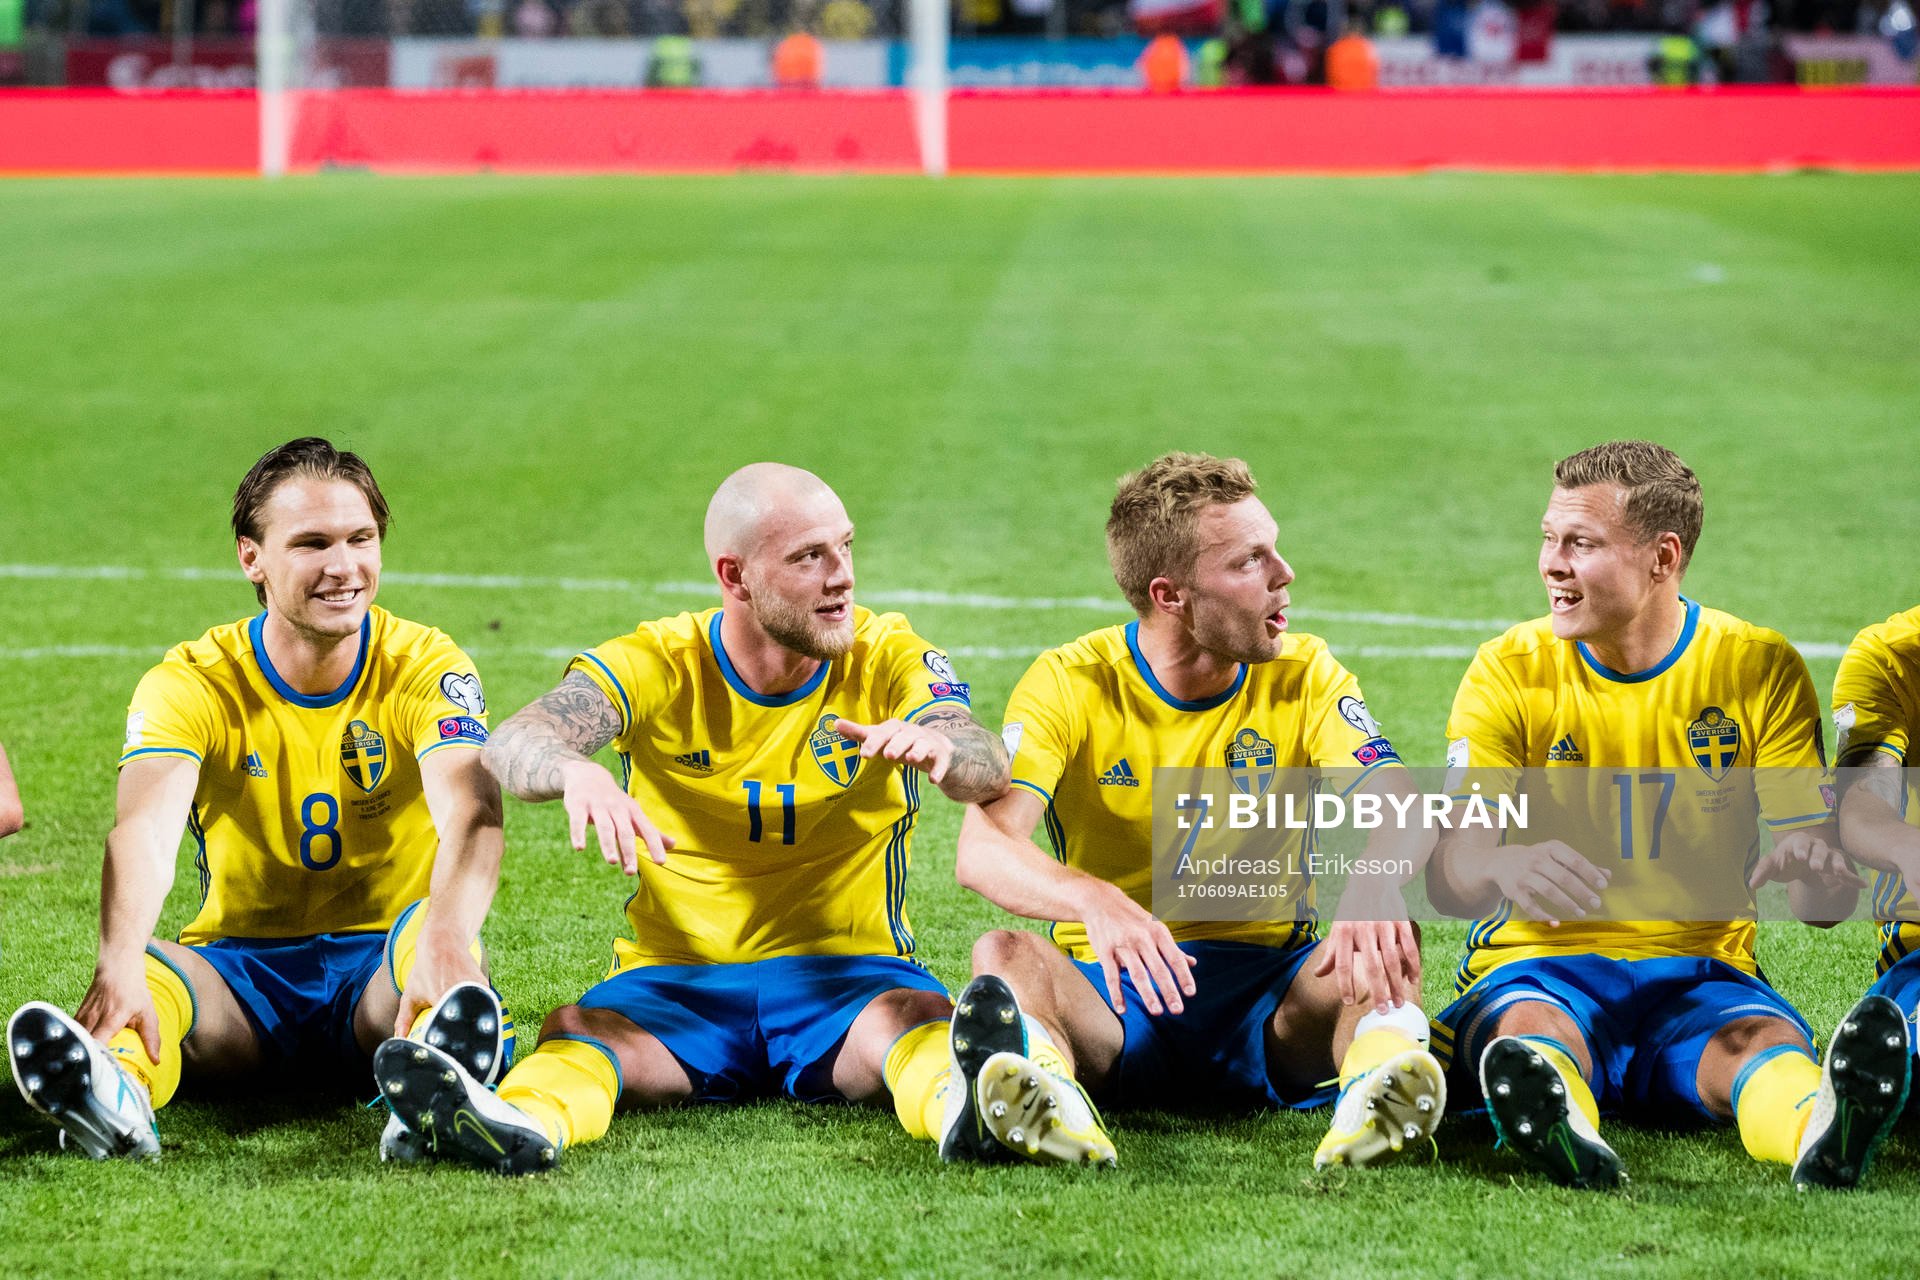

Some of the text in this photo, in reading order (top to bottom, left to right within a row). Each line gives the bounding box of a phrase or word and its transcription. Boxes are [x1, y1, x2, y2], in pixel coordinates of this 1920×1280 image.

[1696, 728, 1731, 737] SVERIGE
[675, 756, 714, 772] adidas
[1233, 749, 1267, 759] SVERIGE
[1098, 776, 1139, 787] adidas
[300, 792, 342, 870] 8
[743, 780, 795, 845] 11
[1613, 773, 1676, 860] 17
[1170, 799, 1208, 880] 7
